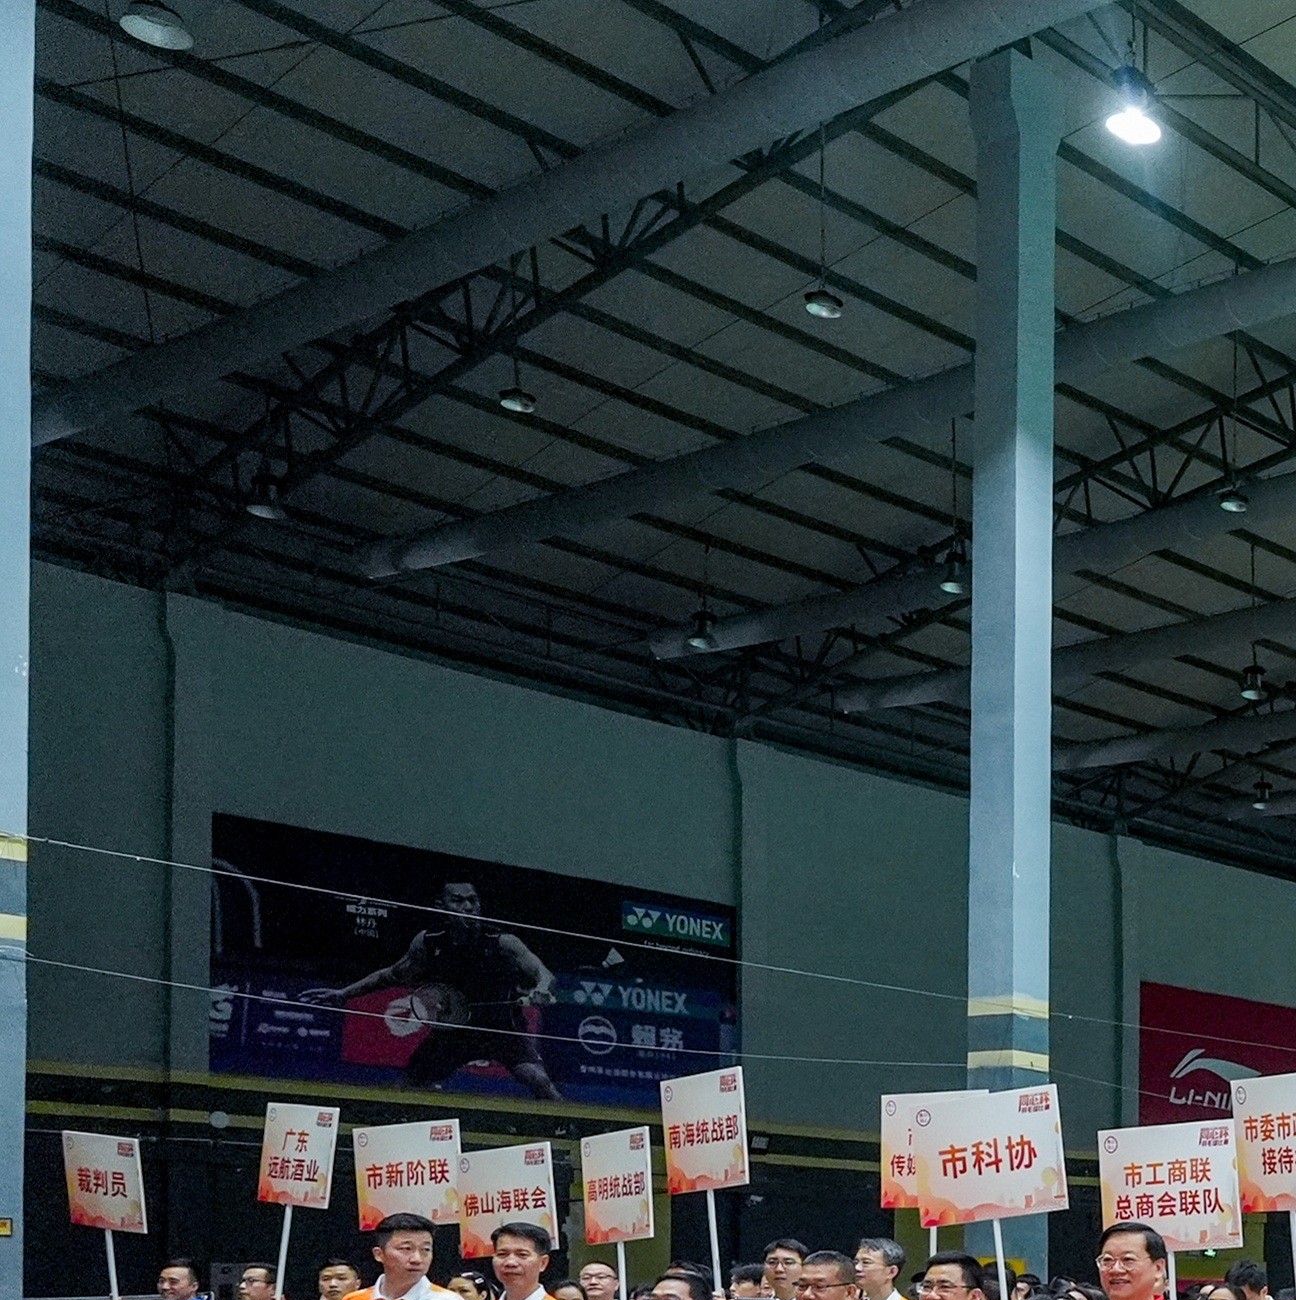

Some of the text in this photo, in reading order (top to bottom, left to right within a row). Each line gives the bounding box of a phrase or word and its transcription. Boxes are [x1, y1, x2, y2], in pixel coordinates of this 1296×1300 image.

[665, 912, 725, 941] YONEX
[618, 985, 690, 1015] YONEX
[1169, 1086, 1232, 1111] LI-NI
[282, 1129, 310, 1152] 广东
[668, 1115, 739, 1150] 南海统战部
[268, 1156, 318, 1183] 远航酒业
[938, 1135, 1037, 1179] 市科协
[1124, 1157, 1211, 1188] 市工商联
[77, 1166, 127, 1198] 裁判员
[366, 1158, 450, 1190] 市新阶联
[587, 1171, 645, 1203] 高明统战部
[464, 1185, 547, 1217] 佛山海联会
[1115, 1188, 1225, 1220] 总商会联队
